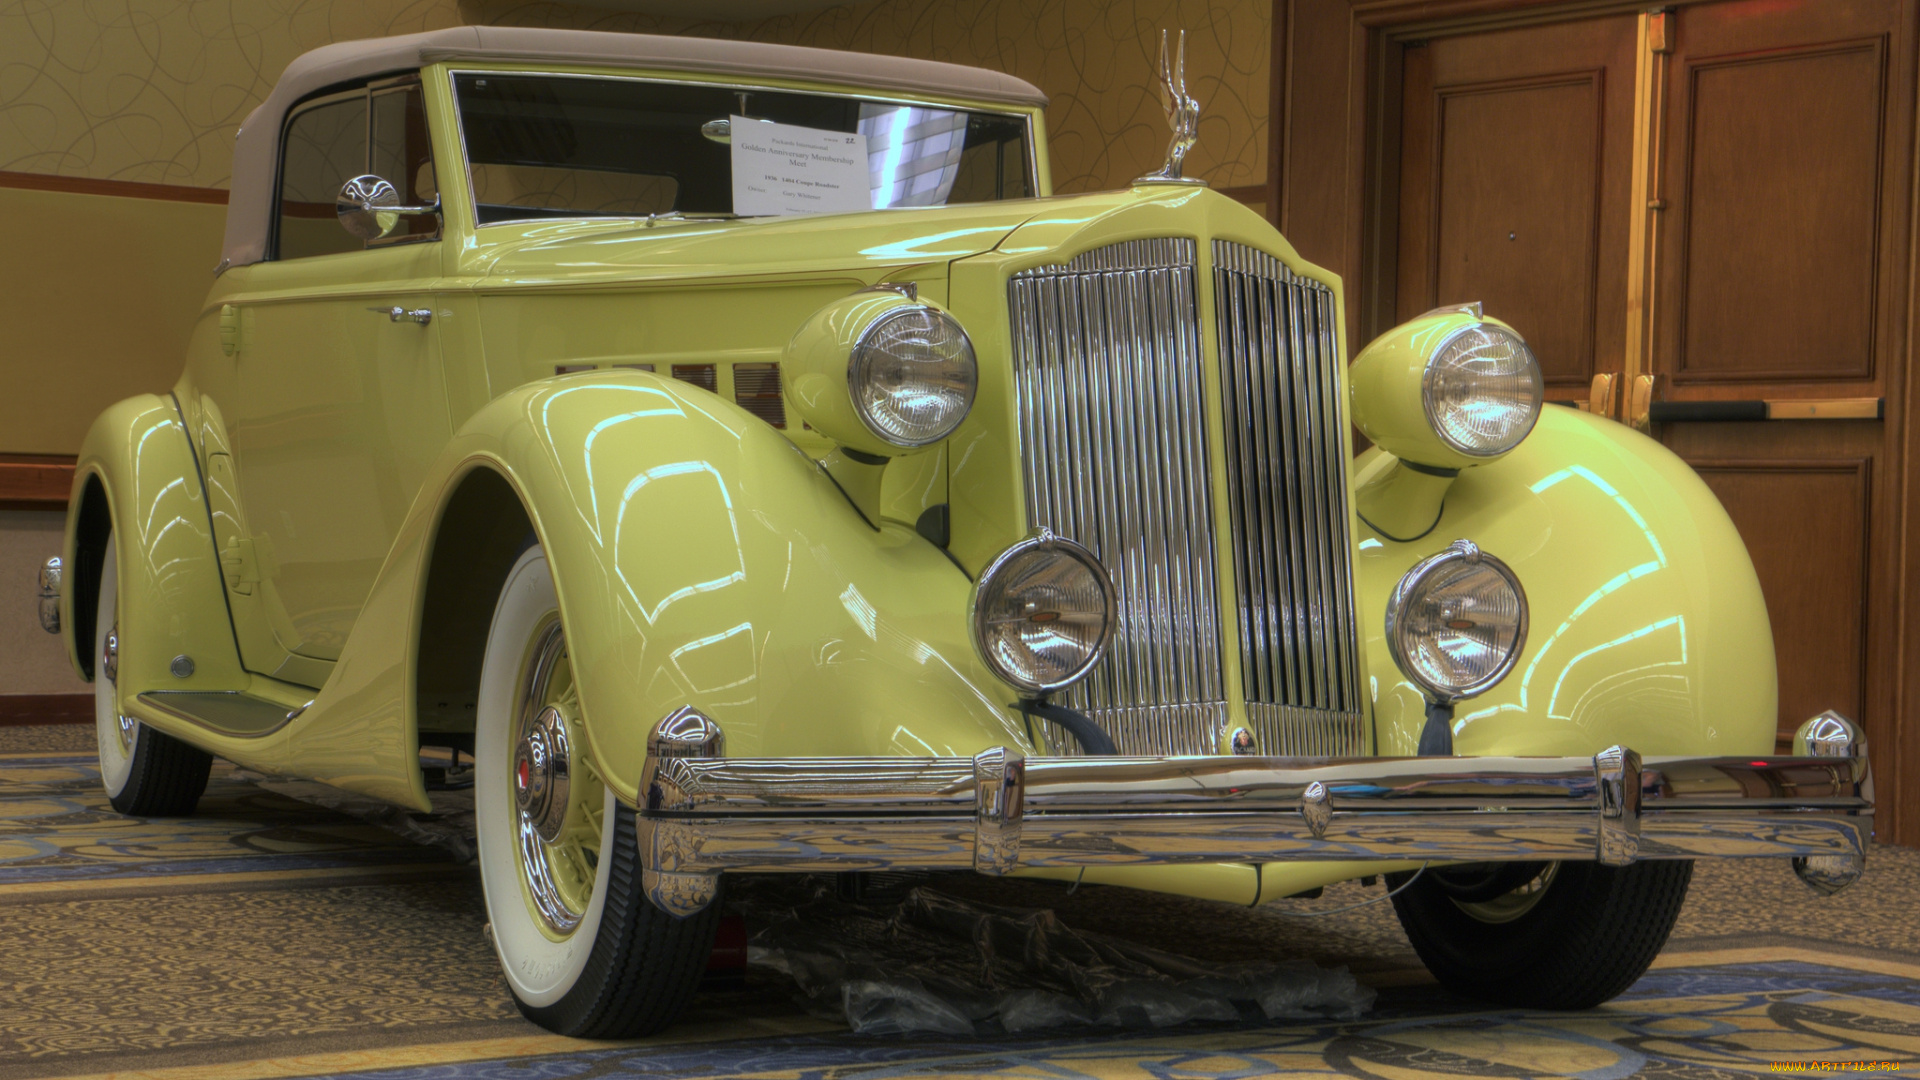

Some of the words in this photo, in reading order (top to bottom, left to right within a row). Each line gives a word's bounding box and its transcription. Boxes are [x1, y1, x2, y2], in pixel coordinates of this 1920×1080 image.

[796, 141, 828, 151] International
[741, 142, 767, 153] Golden
[768, 146, 809, 160] Anniversary
[812, 153, 854, 165] Membership
[789, 158, 807, 167] Meet
[796, 179, 813, 187] Coupe
[815, 181, 839, 189] Roadster
[782, 190, 796, 198] Gary
